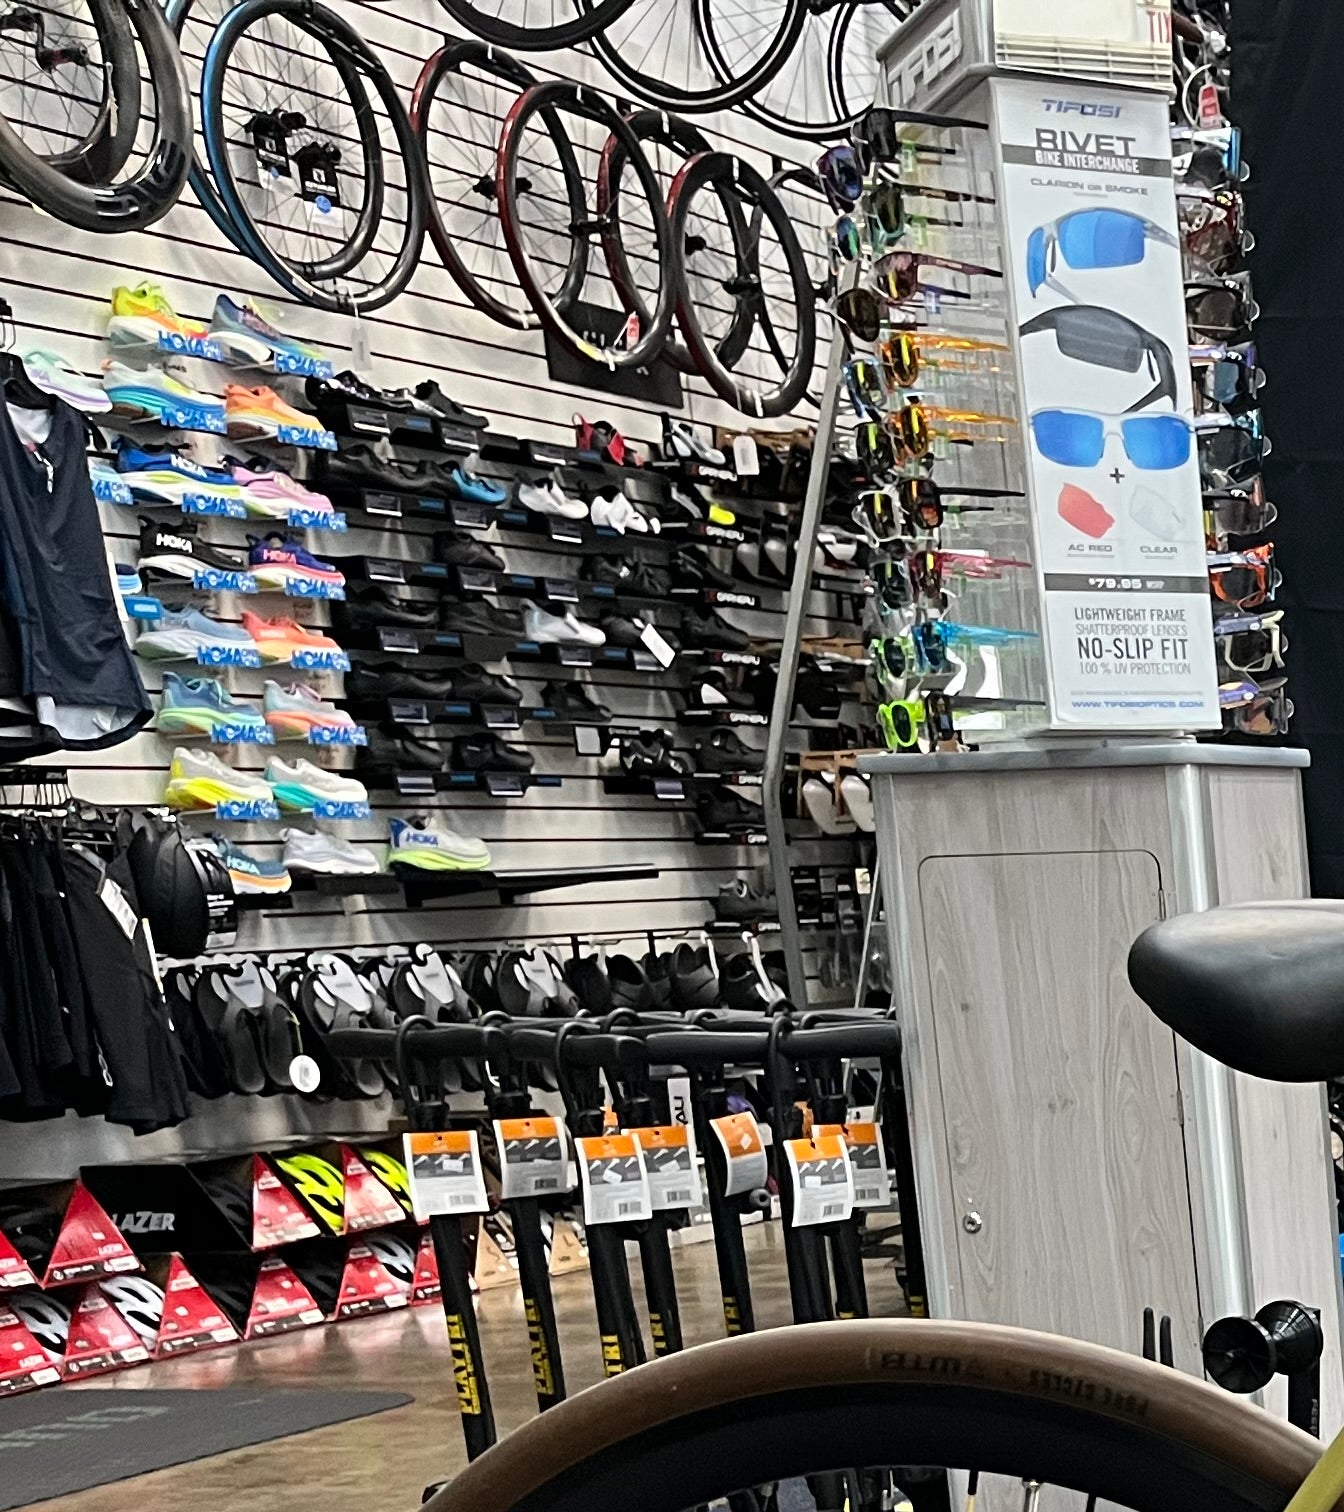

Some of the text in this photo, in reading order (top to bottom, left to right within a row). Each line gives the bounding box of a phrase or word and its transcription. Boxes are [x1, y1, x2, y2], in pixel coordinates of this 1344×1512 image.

[1042, 99, 1122, 118] TIFOSI
[1035, 128, 1136, 156] RIVET
[1035, 149, 1140, 173] BIKE INTERCHANGE
[1105, 183, 1148, 195] SMOKE
[156, 533, 193, 554] HOKA
[1068, 544, 1113, 552] AC RED
[1139, 546, 1178, 554] CLEAR
[263, 549, 298, 564] HOKA
[1074, 608, 1186, 622] LIGHTWEIGHT FRAME
[1075, 623, 1188, 636] SHATTERPROOF LENSES
[1077, 637, 1188, 659] NO-SLIP FIT
[1080, 662, 1191, 675] 100 % UV PROTECTION
[406, 832, 438, 847] HOKA
[227, 855, 260, 875] HOKA
[112, 1211, 175, 1234] LAZER
